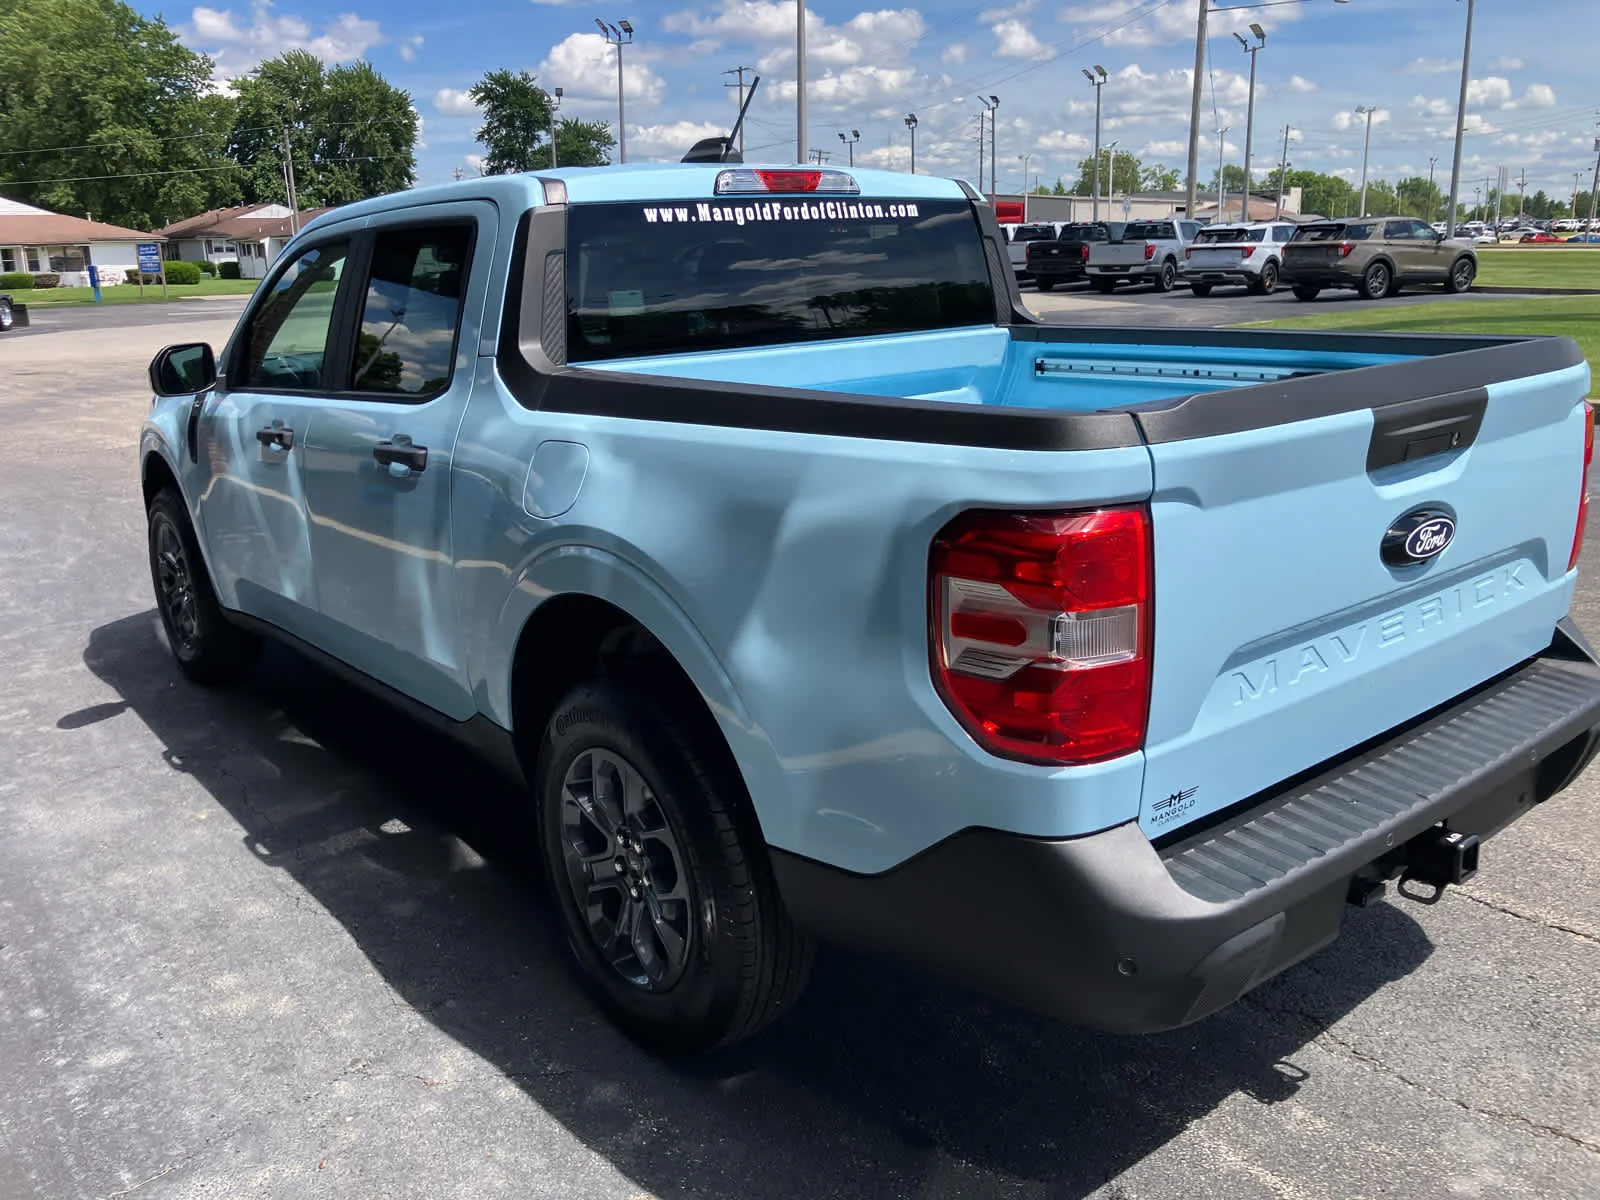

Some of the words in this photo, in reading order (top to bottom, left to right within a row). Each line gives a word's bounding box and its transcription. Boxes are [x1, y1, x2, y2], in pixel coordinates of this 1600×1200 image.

[644, 202, 919, 225] www.MangoldFordofClinton.com
[1415, 523, 1447, 554] Ford
[1232, 562, 1525, 706] MAVERICK
[1151, 799, 1196, 824] MANGOLD
